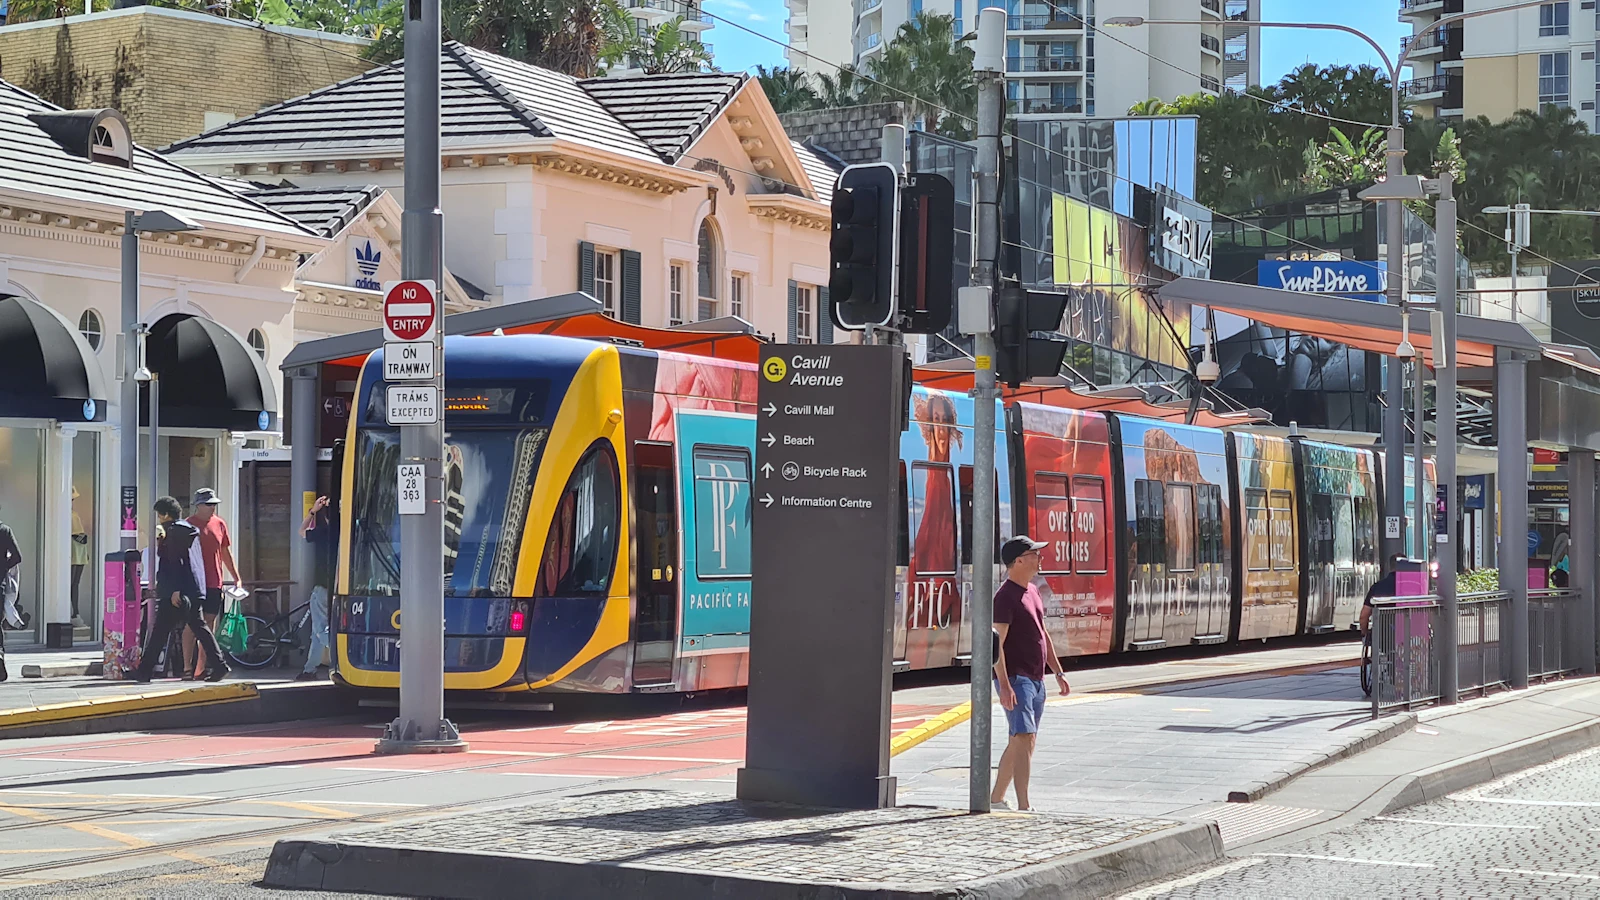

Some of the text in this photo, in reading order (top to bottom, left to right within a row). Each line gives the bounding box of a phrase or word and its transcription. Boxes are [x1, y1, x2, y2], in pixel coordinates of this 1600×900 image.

[355, 278, 381, 291] adidas
[402, 289, 417, 300] NO
[393, 319, 425, 331] ENTRY
[402, 348, 417, 359] ON
[791, 355, 830, 369] Cavill
[388, 363, 431, 374] TRAMWAY
[790, 372, 844, 387] Avenue
[396, 393, 429, 403] TRAMS
[391, 407, 434, 418] EXCEPTED
[784, 404, 834, 415] Cavill Mall
[783, 435, 815, 446] Beach
[401, 467, 421, 477] CAA
[803, 466, 867, 478] Bicycle Rack
[406, 479, 417, 489] 28
[403, 490, 420, 501] 363
[781, 496, 872, 508] Information Centre
[1048, 510, 1095, 534] OVER 400
[1275, 519, 1291, 537] DAYS
[1055, 540, 1090, 562] STORES
[690, 593, 749, 609] PACIFIC FA
[1130, 577, 1193, 620] PACIFIC
[352, 601, 364, 614] 04
